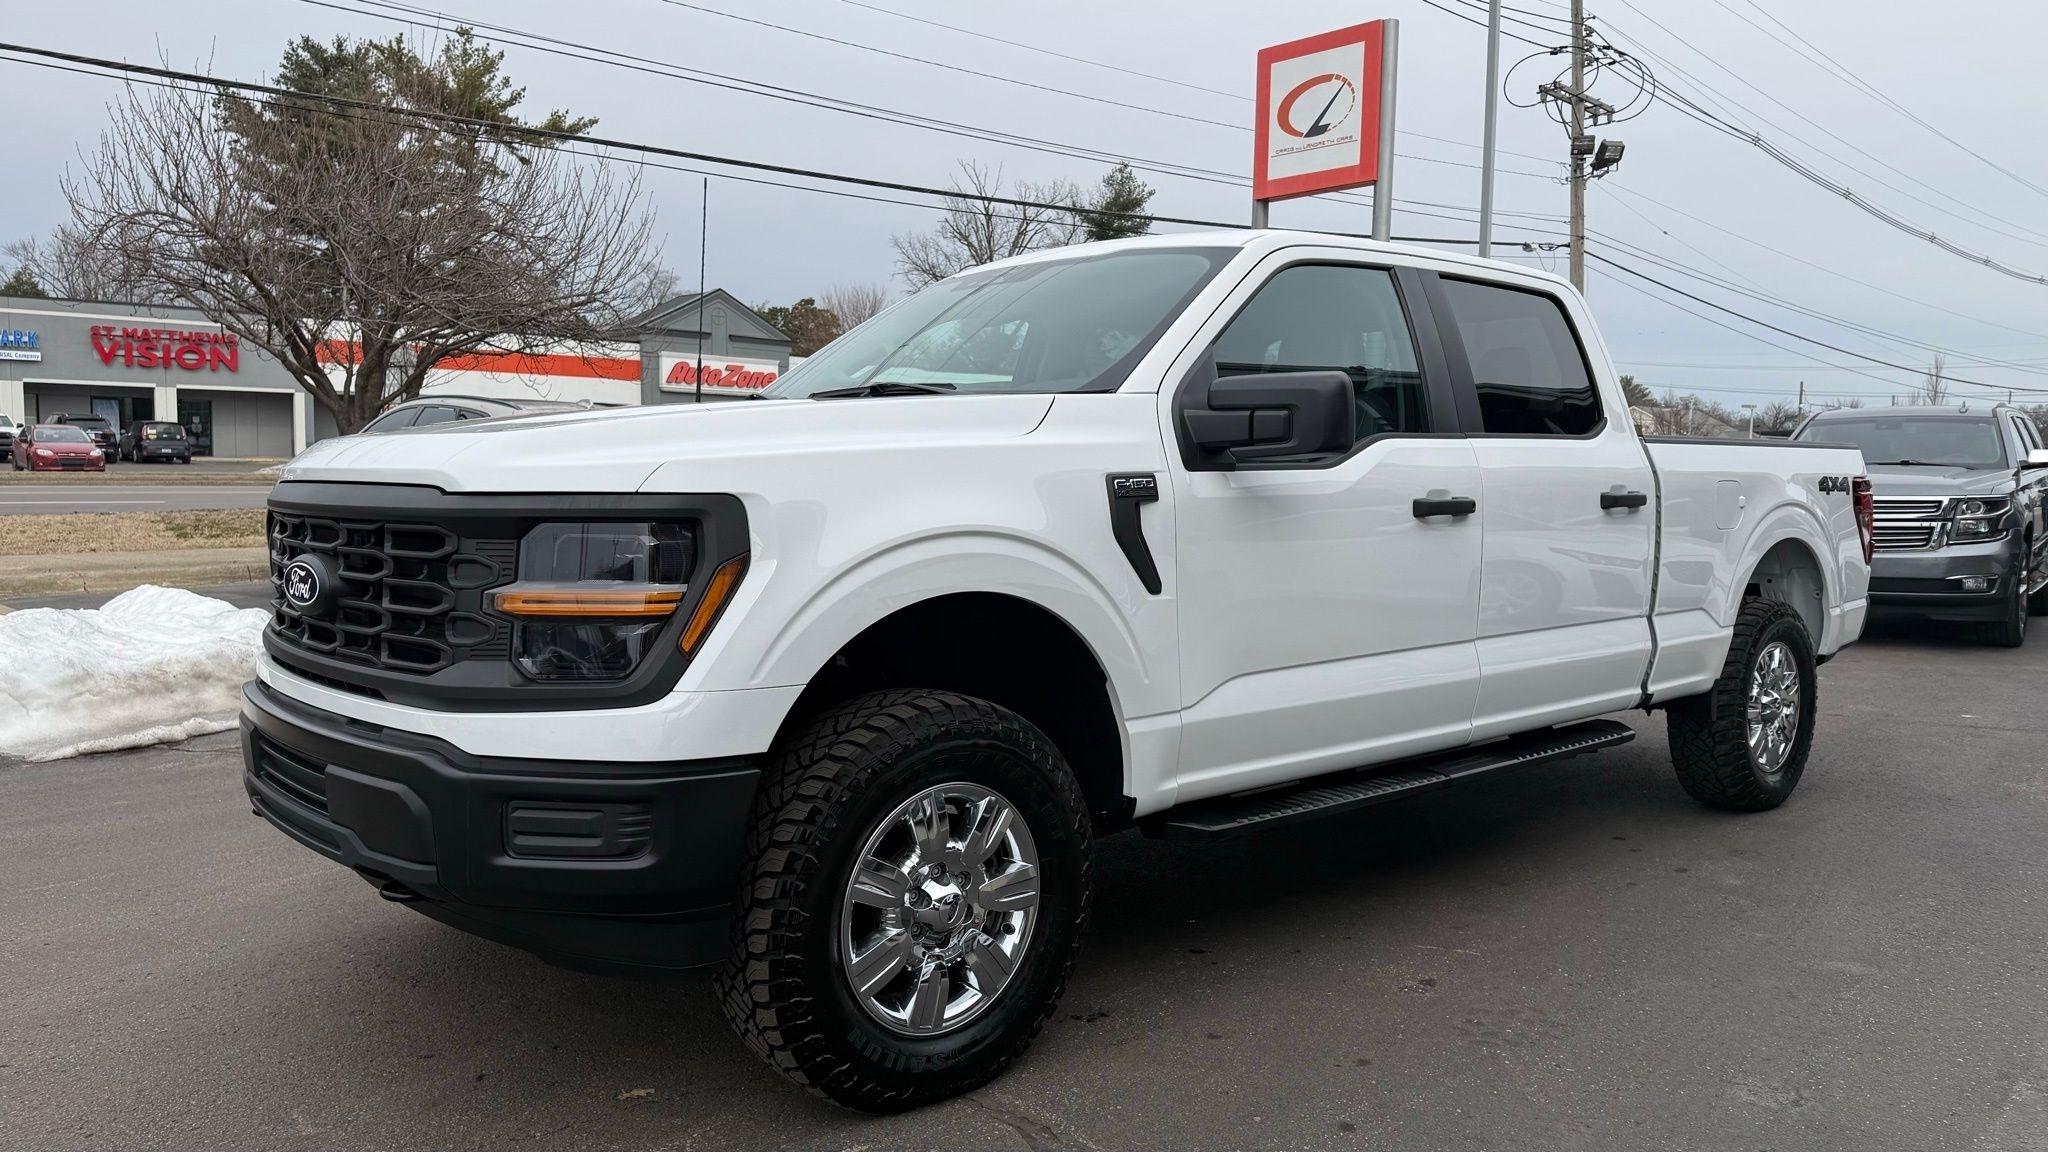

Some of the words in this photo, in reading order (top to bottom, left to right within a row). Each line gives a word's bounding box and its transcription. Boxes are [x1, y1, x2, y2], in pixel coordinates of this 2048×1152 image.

[122, 327, 238, 345] MATTHEWS
[91, 336, 239, 373] VISION
[666, 361, 777, 389] AutoZone
[1113, 478, 1154, 489] F-150
[289, 567, 311, 599] Ford
